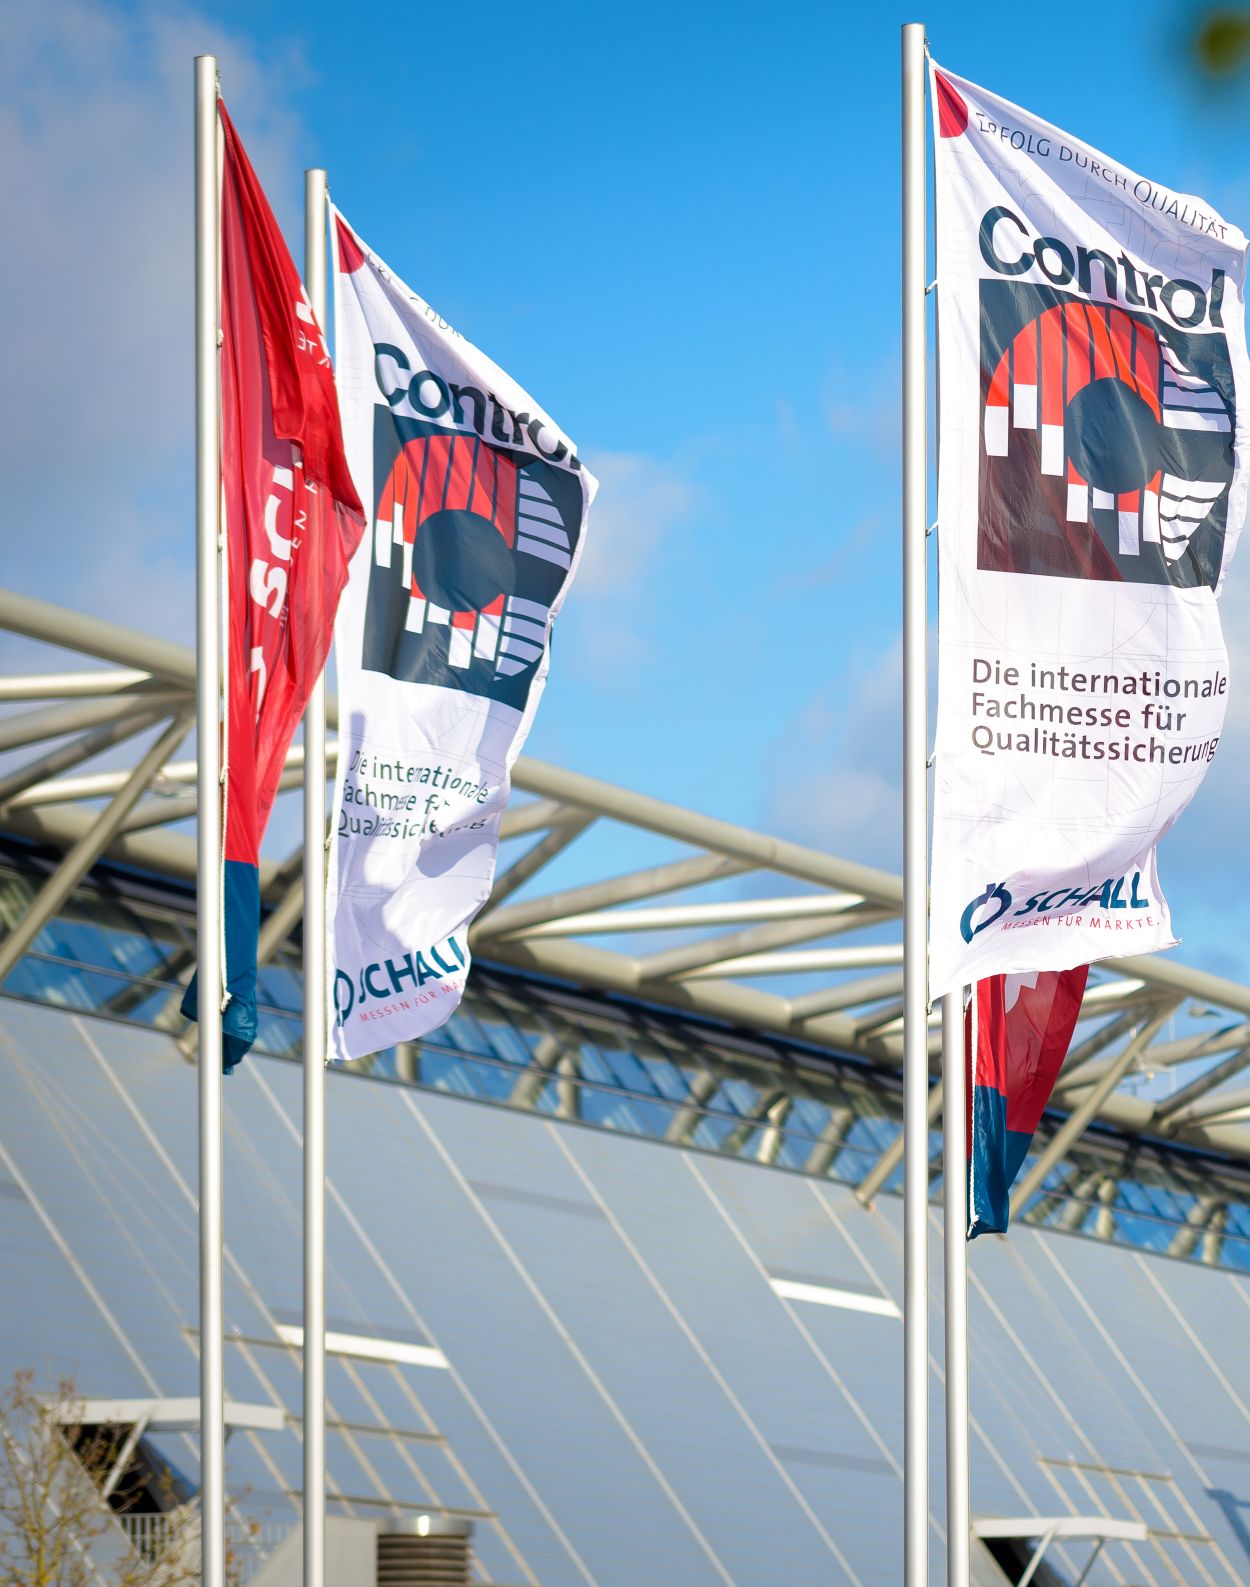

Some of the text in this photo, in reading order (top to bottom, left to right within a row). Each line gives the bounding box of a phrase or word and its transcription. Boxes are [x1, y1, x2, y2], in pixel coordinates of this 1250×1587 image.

[1059, 145, 1127, 191] DURCH
[1133, 180, 1229, 240] QUALITÄT
[979, 205, 1226, 329] Control
[374, 342, 581, 472] Contro
[972, 658, 1227, 699] Die internationale
[971, 692, 1187, 731] Fachmesse für
[971, 725, 1220, 765] Qualitätssicherung
[1013, 871, 1150, 917] SCHALL
[1001, 915, 1050, 931] MESSEN
[1057, 912, 1083, 927] FÜR
[360, 1000, 411, 1022] MESSEN
